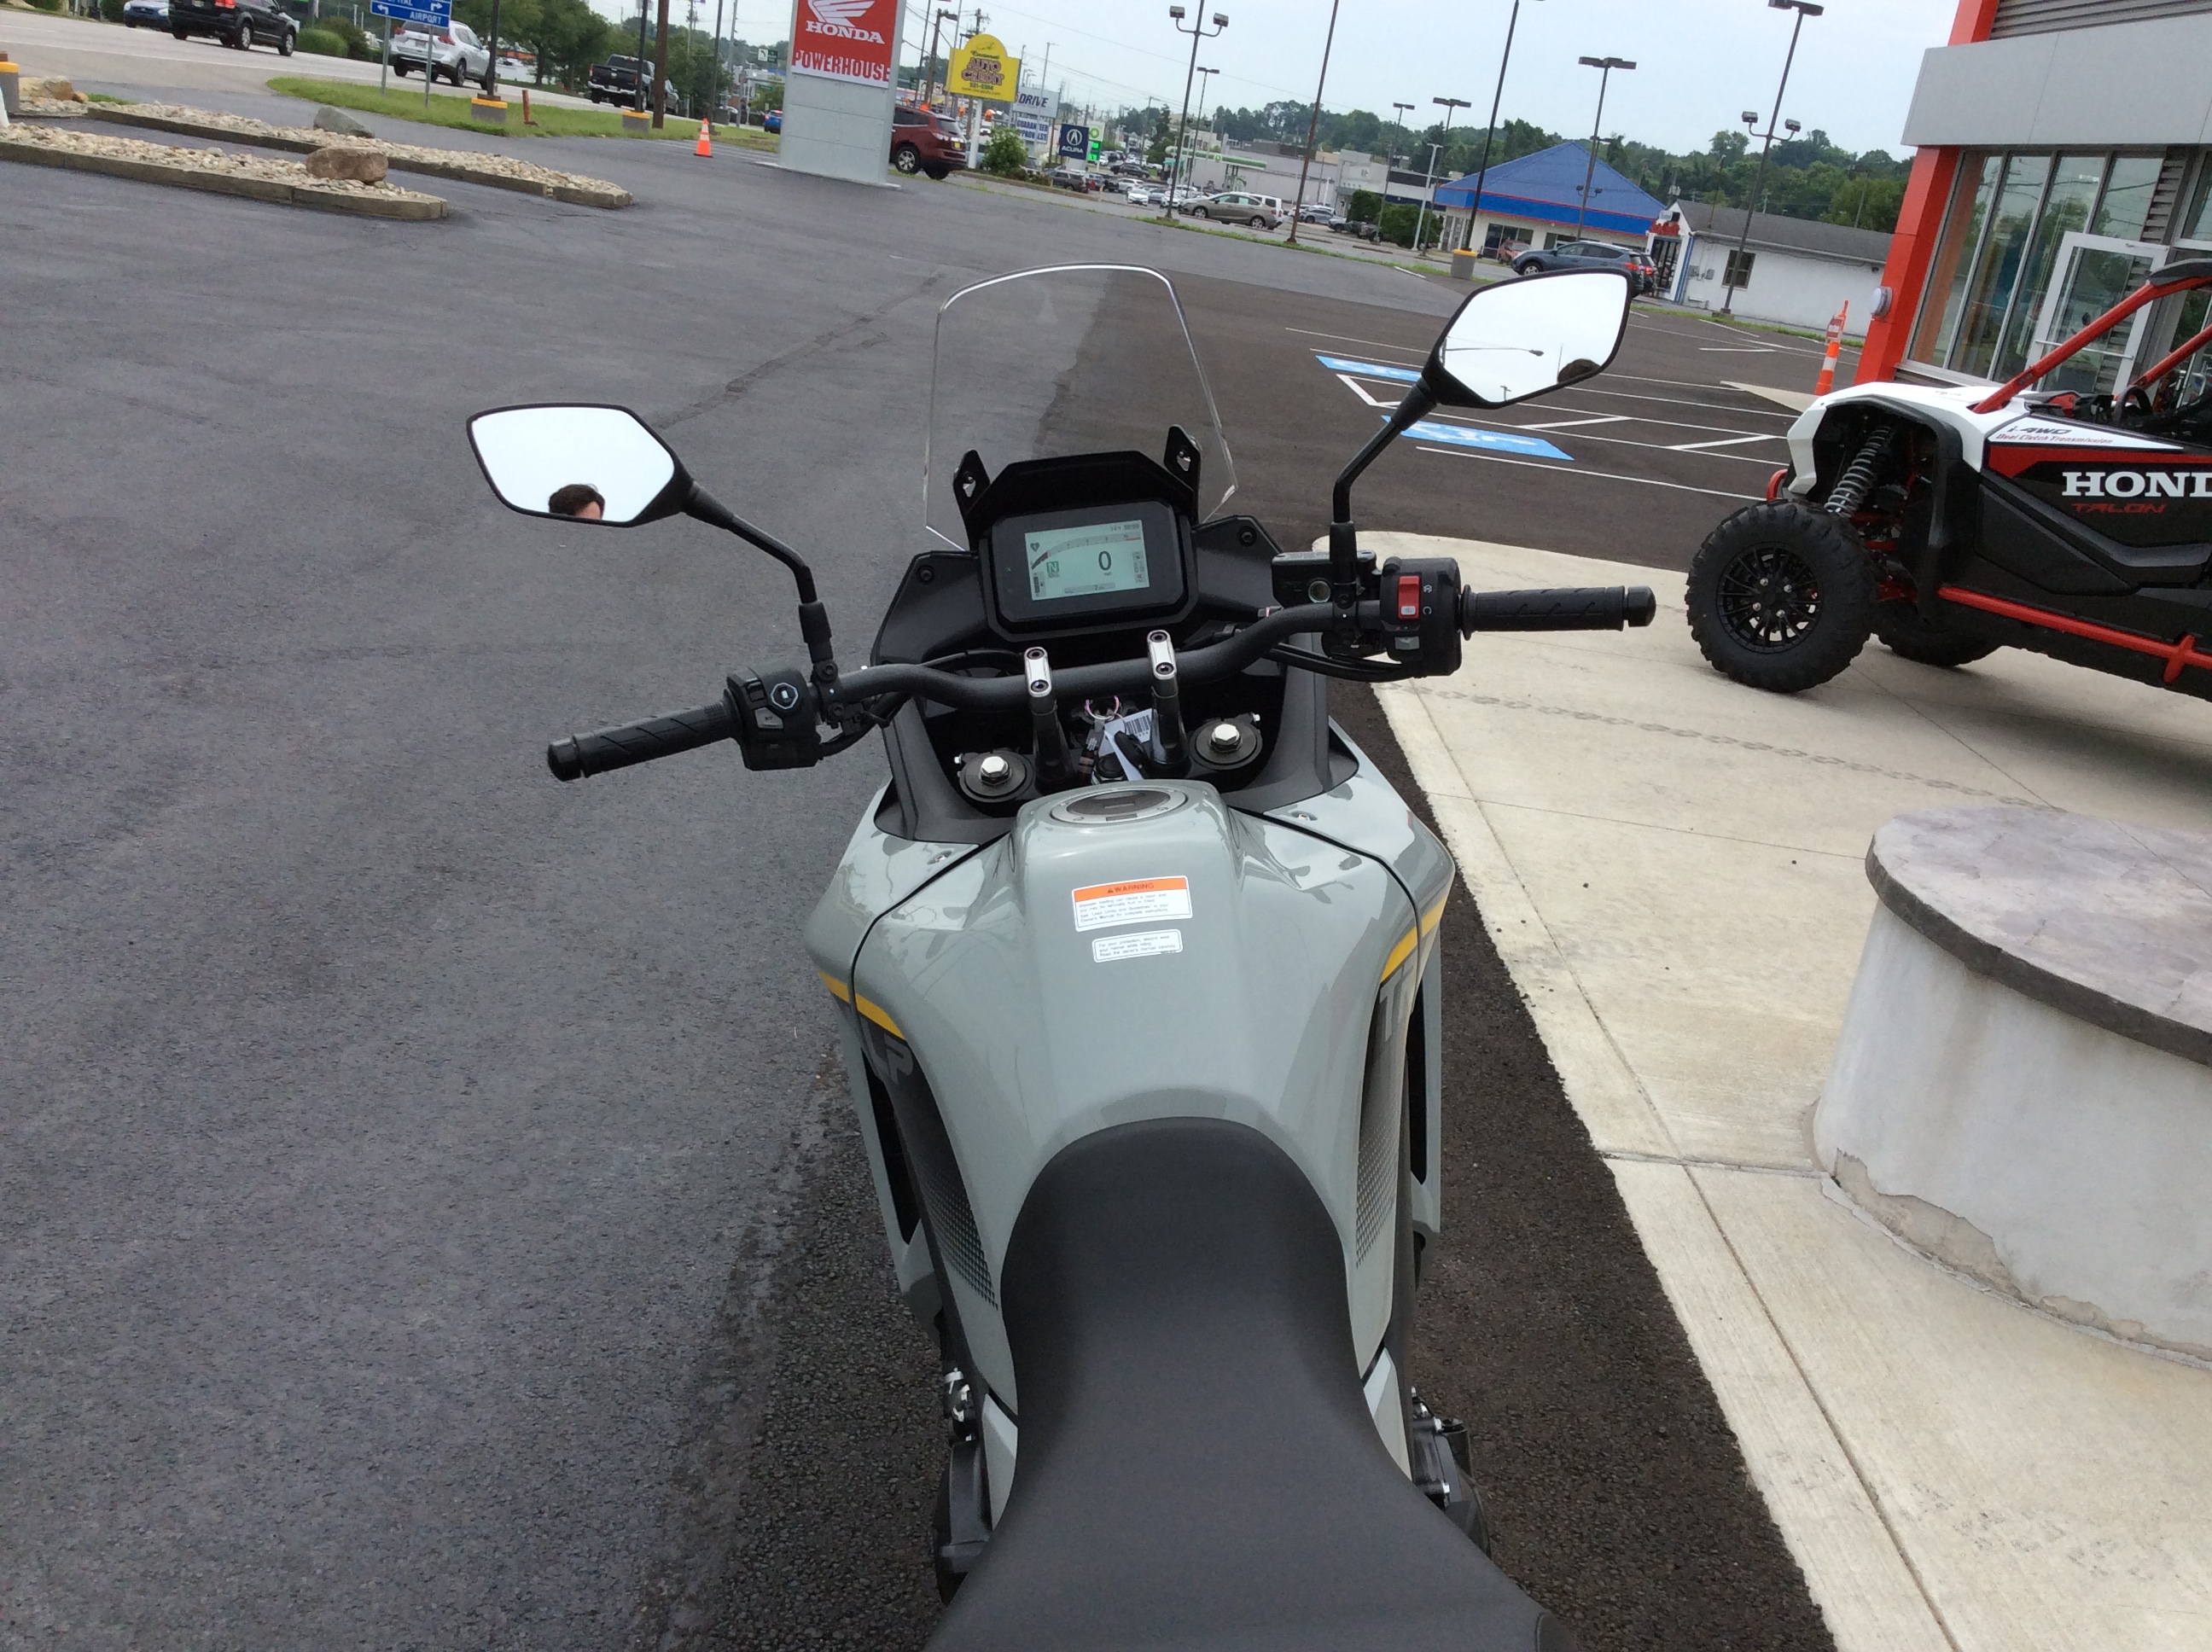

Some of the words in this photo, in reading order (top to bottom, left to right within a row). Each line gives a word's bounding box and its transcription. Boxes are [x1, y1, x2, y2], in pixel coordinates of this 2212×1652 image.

[410, 11, 442, 25] AIRPORT
[806, 20, 885, 44] HONDA
[792, 49, 890, 83] POWERHOUSE
[967, 57, 1002, 73] AUTO
[961, 69, 1005, 85] CREDIT
[1062, 145, 1084, 154] ACURA
[2051, 435, 2114, 444] Transmission
[2072, 503, 2167, 514] TALON
[1098, 550, 1112, 571] 0
[1114, 882, 1155, 893] WARNING
